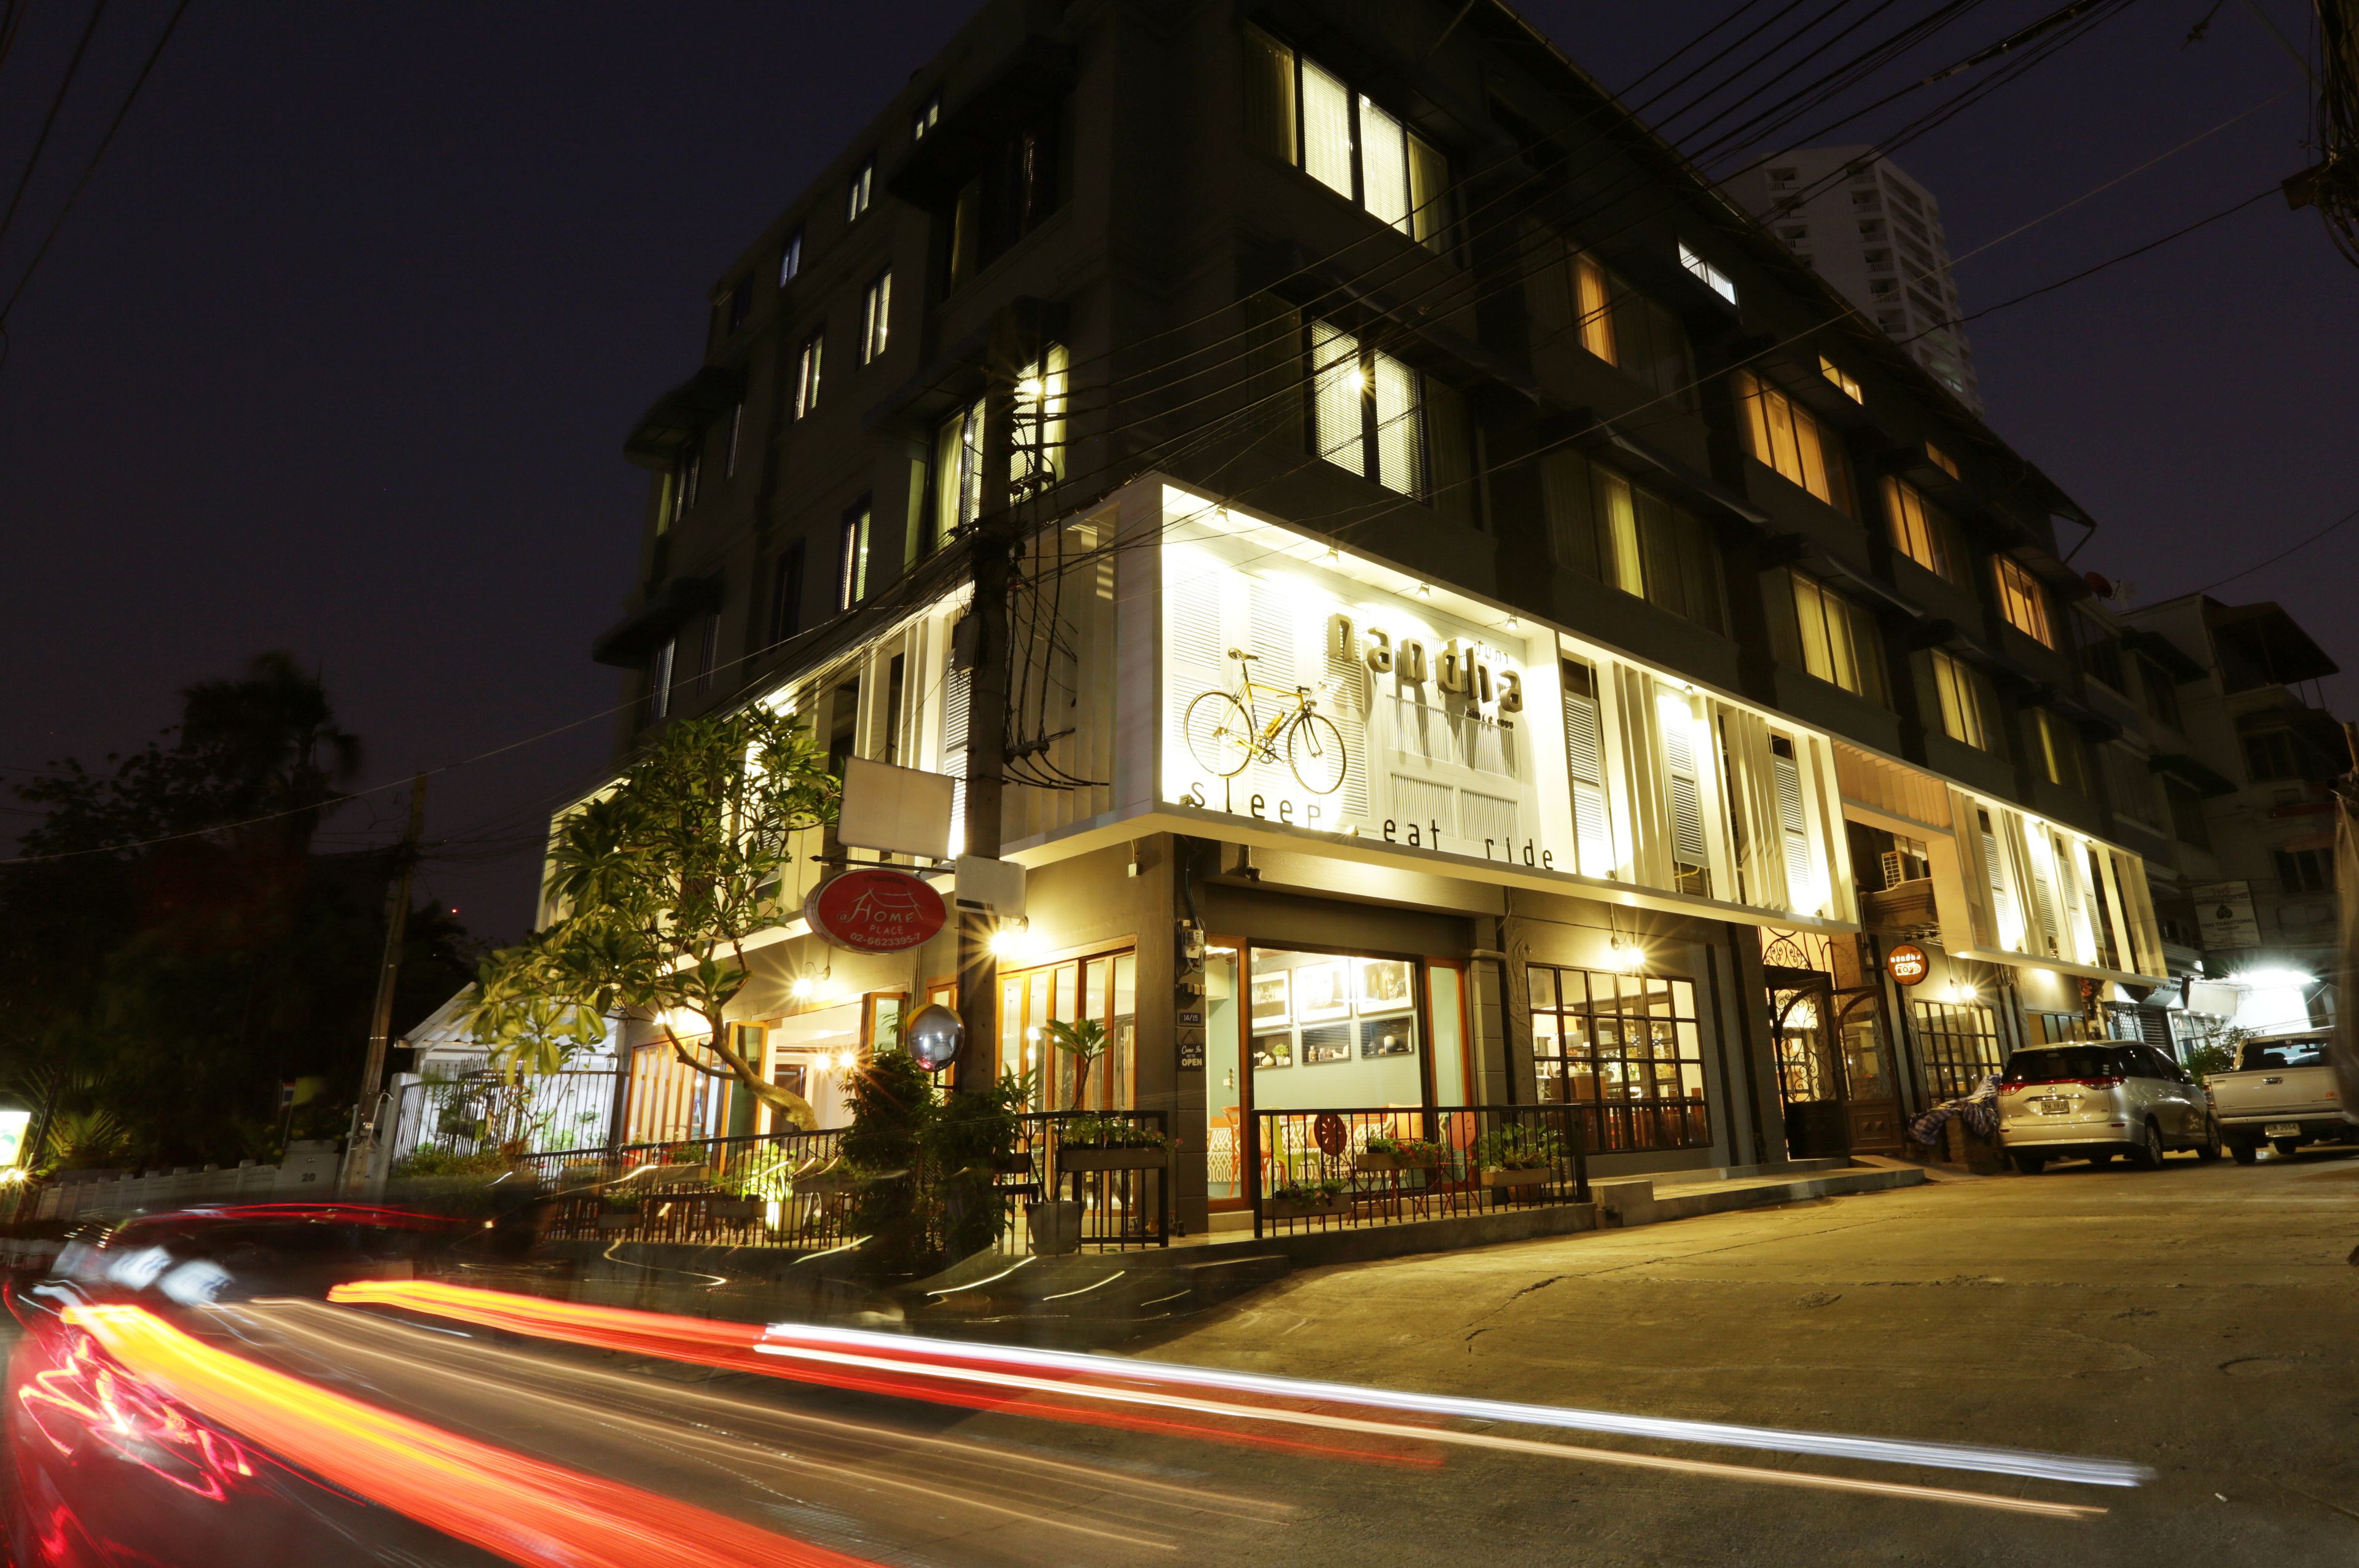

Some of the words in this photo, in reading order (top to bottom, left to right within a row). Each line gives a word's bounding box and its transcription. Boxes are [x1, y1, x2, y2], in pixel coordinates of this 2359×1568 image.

[1327, 613, 1523, 712] nandha
[1189, 778, 1321, 829] sleep
[1384, 818, 1441, 851] eat
[1486, 836, 1554, 870] ride
[2216, 918, 2255, 928] TRADITIONAL
[869, 923, 904, 935] PLACE
[850, 932, 921, 947] 02-6623395-7
[1890, 953, 1922, 963] nandha
[1181, 1058, 1202, 1067] OPEN
[301, 1172, 316, 1182] 20
